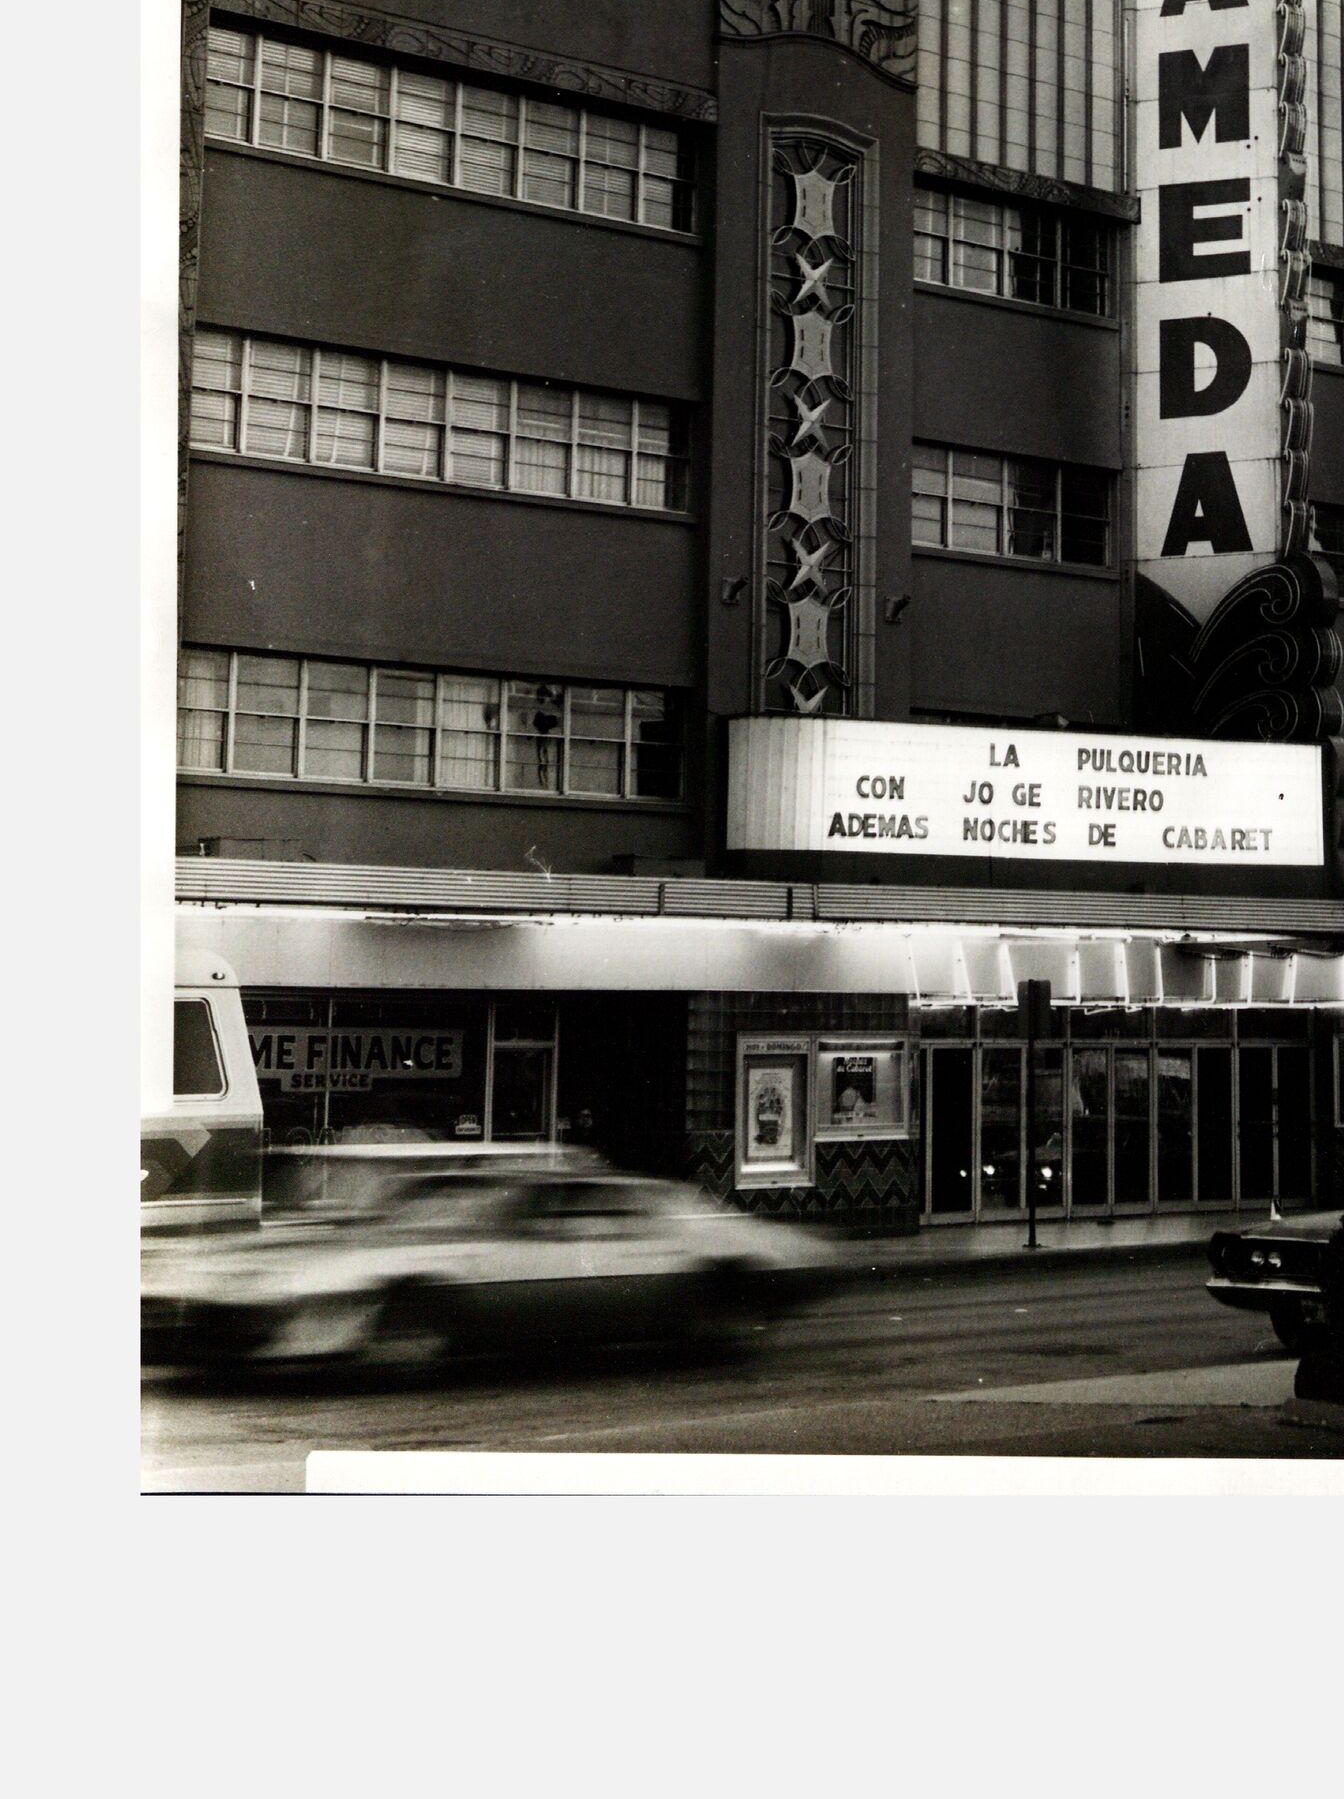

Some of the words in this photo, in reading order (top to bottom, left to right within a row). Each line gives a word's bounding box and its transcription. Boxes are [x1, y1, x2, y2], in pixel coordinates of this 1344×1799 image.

[989, 743, 1021, 768] LA
[1077, 747, 1208, 777] PULQUERIA
[855, 775, 905, 800] CON
[1077, 786, 1164, 812] RIVERO
[827, 812, 929, 840] ADEMAS
[962, 817, 1057, 845] NOCHES
[1088, 823, 1117, 848] DE
[1162, 826, 1271, 851] CABARET
[306, 1034, 454, 1072] FINANCE
[290, 1073, 370, 1090] SERVICE
